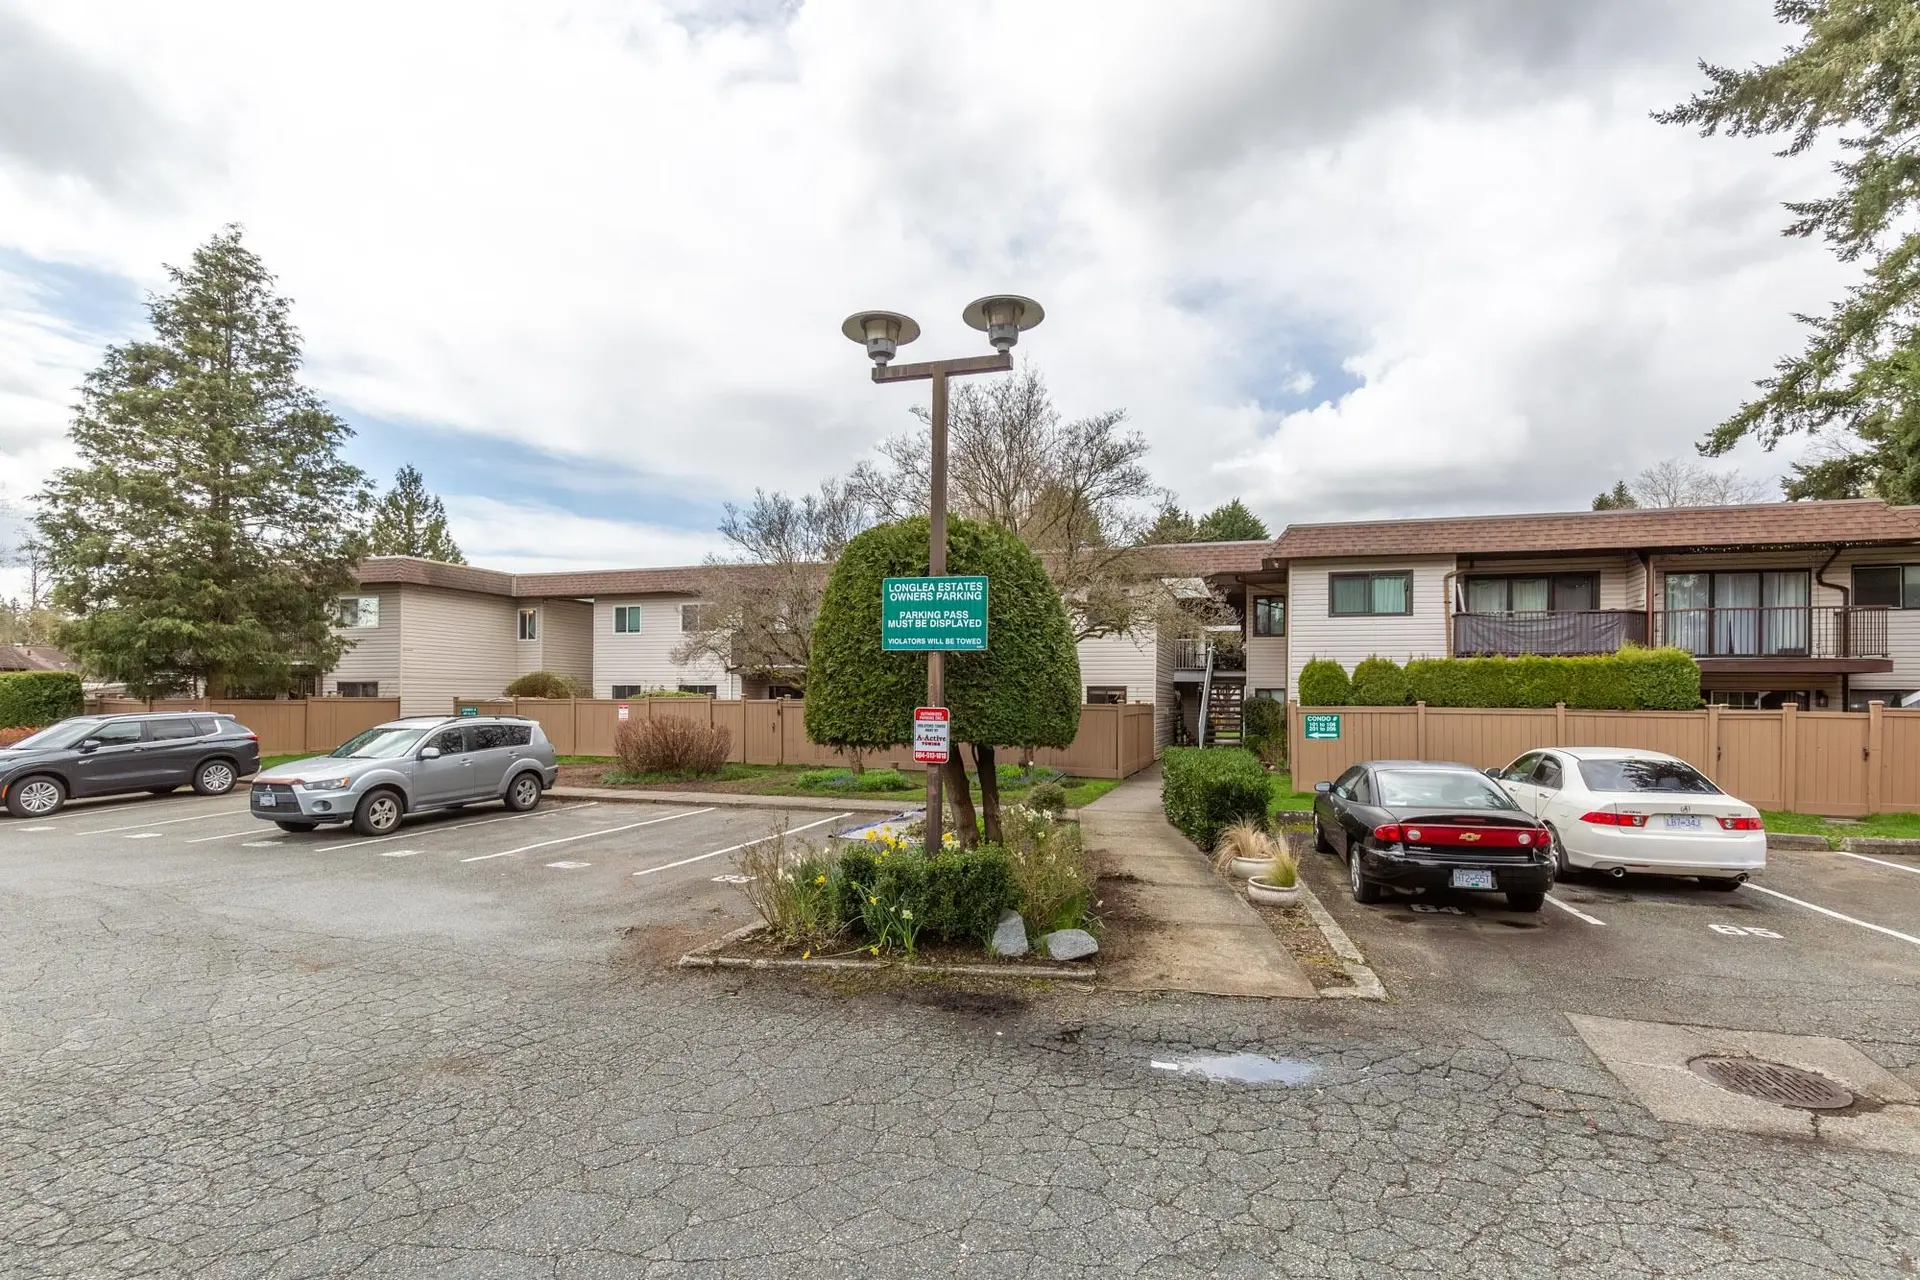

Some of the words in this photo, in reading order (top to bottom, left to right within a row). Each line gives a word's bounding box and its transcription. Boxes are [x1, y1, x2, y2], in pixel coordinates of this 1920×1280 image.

[888, 583, 935, 592] LONGLEA
[937, 582, 983, 591] ESTATES
[890, 592, 933, 601] OWNERS
[936, 591, 982, 600] PARKING
[899, 611, 941, 619] PARKING
[943, 610, 969, 619] PASS
[887, 619, 914, 628] MUST
[915, 619, 927, 628] BE
[929, 619, 982, 628] DISPLAYED
[956, 637, 982, 645] TOWED
[916, 734, 946, 742] A-Active
